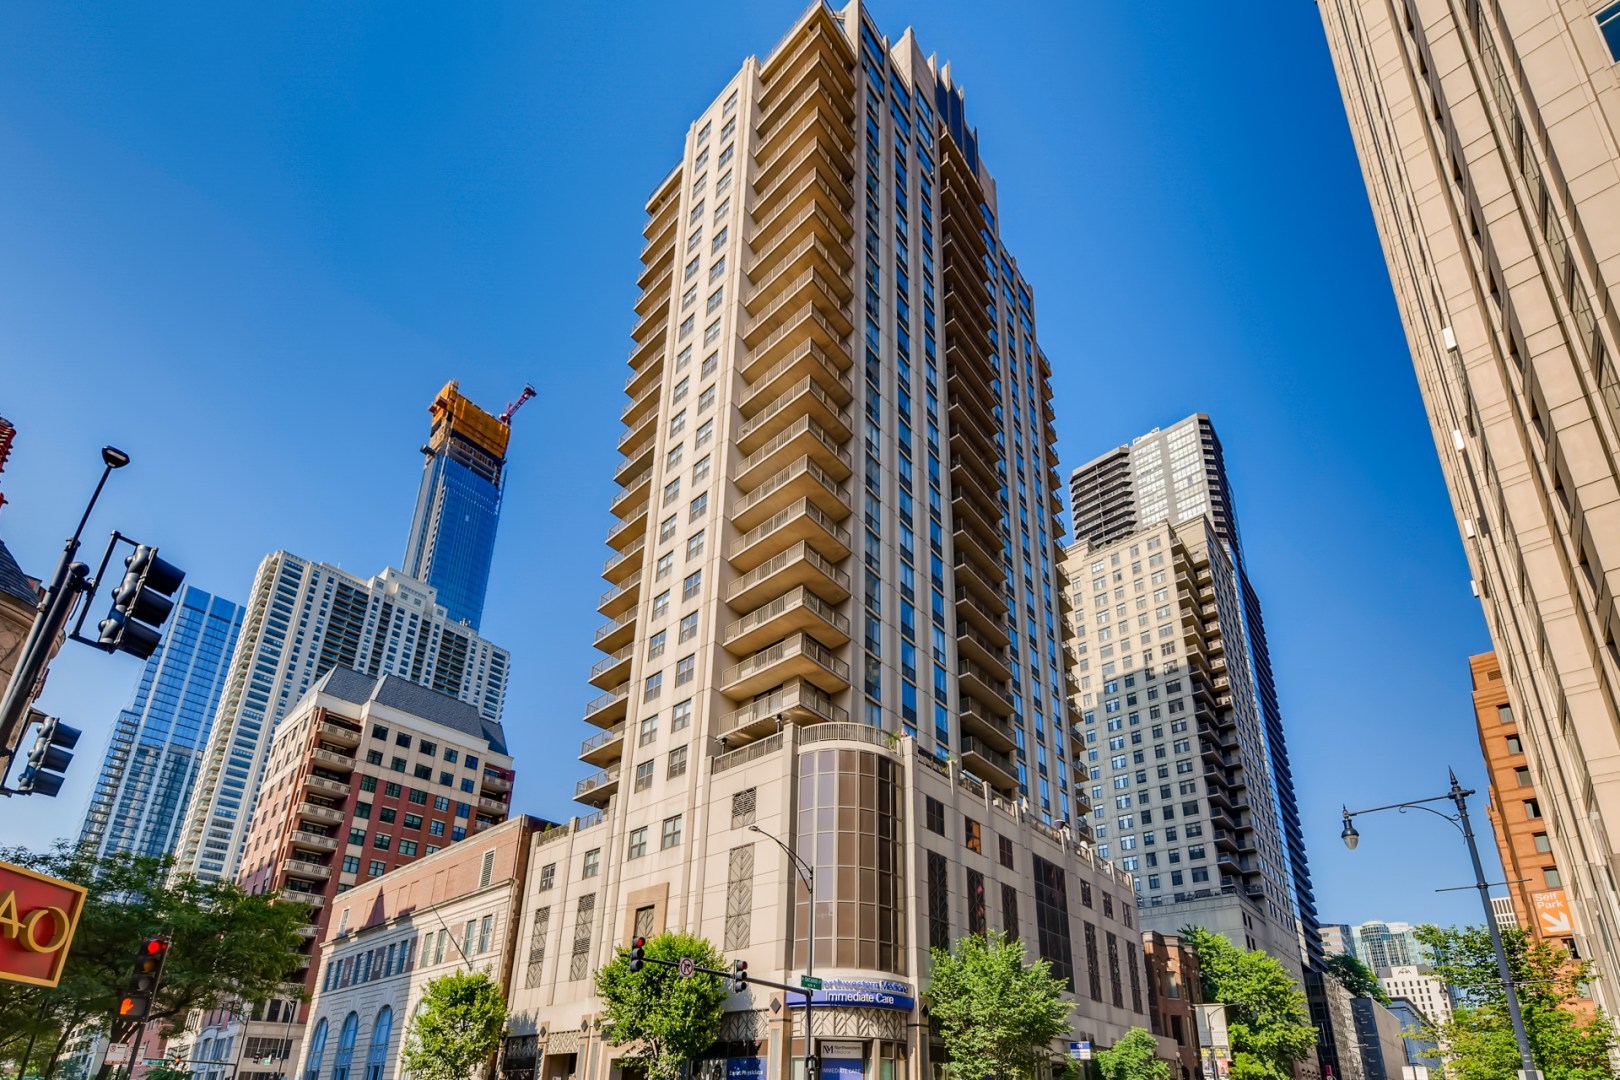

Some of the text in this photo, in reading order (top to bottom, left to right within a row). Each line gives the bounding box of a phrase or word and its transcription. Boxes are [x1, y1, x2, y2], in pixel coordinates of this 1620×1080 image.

[1535, 892, 1557, 901] Self
[1537, 900, 1564, 909] Park
[881, 980, 908, 993] Medicine
[825, 991, 895, 1005] Immediate Care
